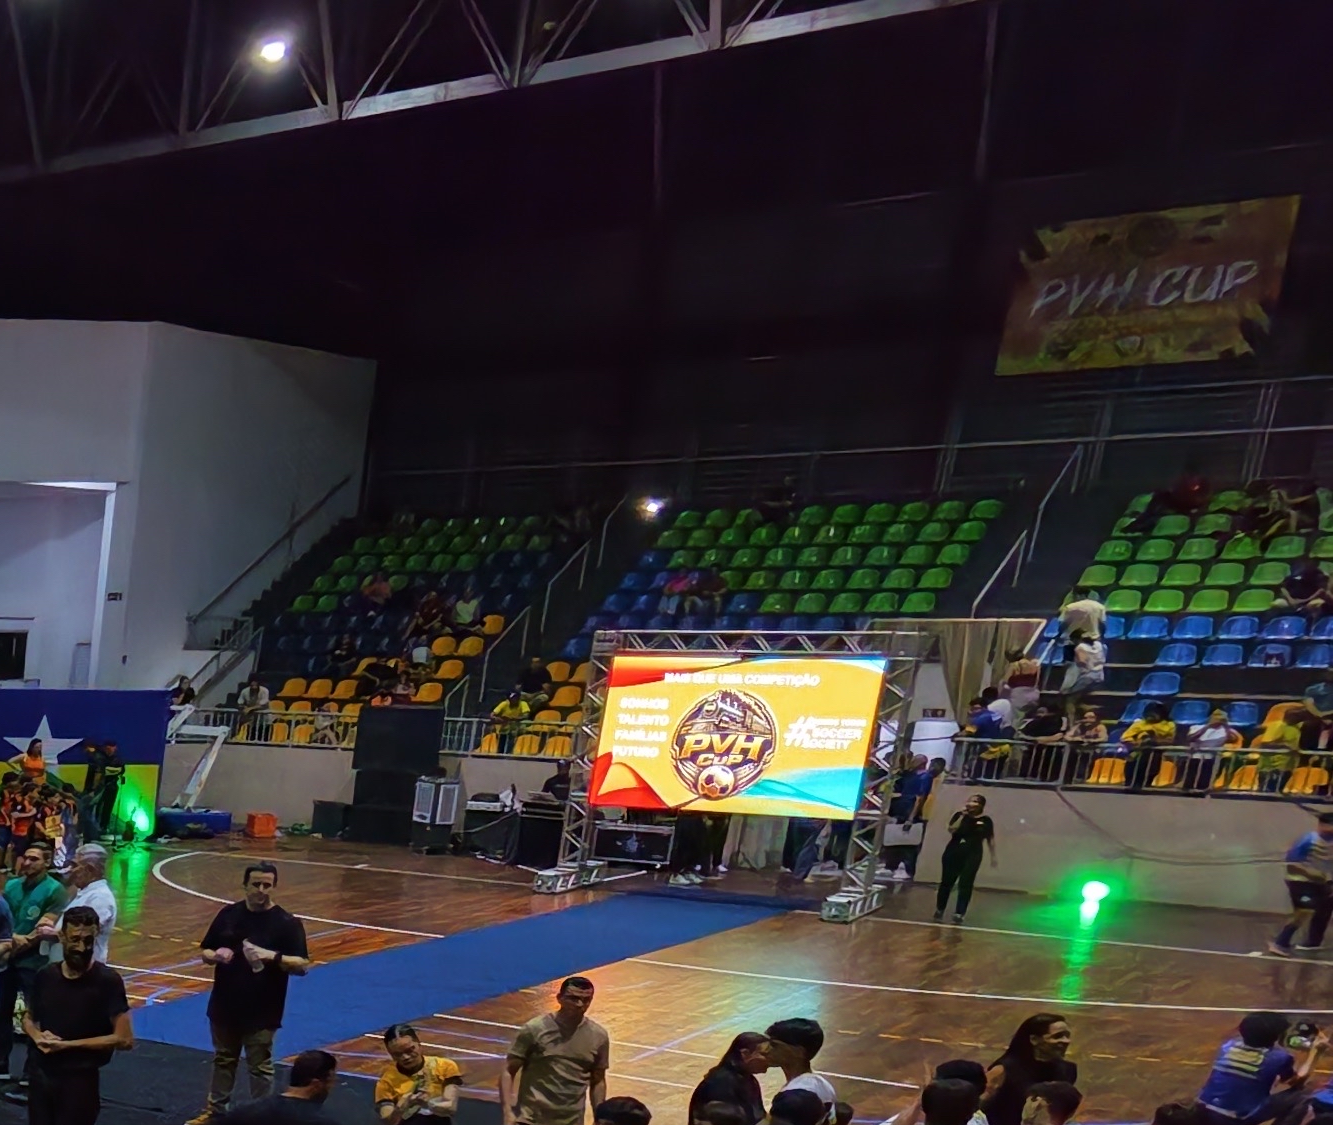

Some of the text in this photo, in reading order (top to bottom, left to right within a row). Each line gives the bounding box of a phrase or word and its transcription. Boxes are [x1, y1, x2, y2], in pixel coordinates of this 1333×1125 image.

[1029, 259, 1259, 319] PVH CUP
[744, 673, 820, 687] COMPETIÇÃO
[618, 714, 670, 726] TALENTO
[612, 745, 659, 757] FUTURO
[681, 734, 767, 760] PVH
